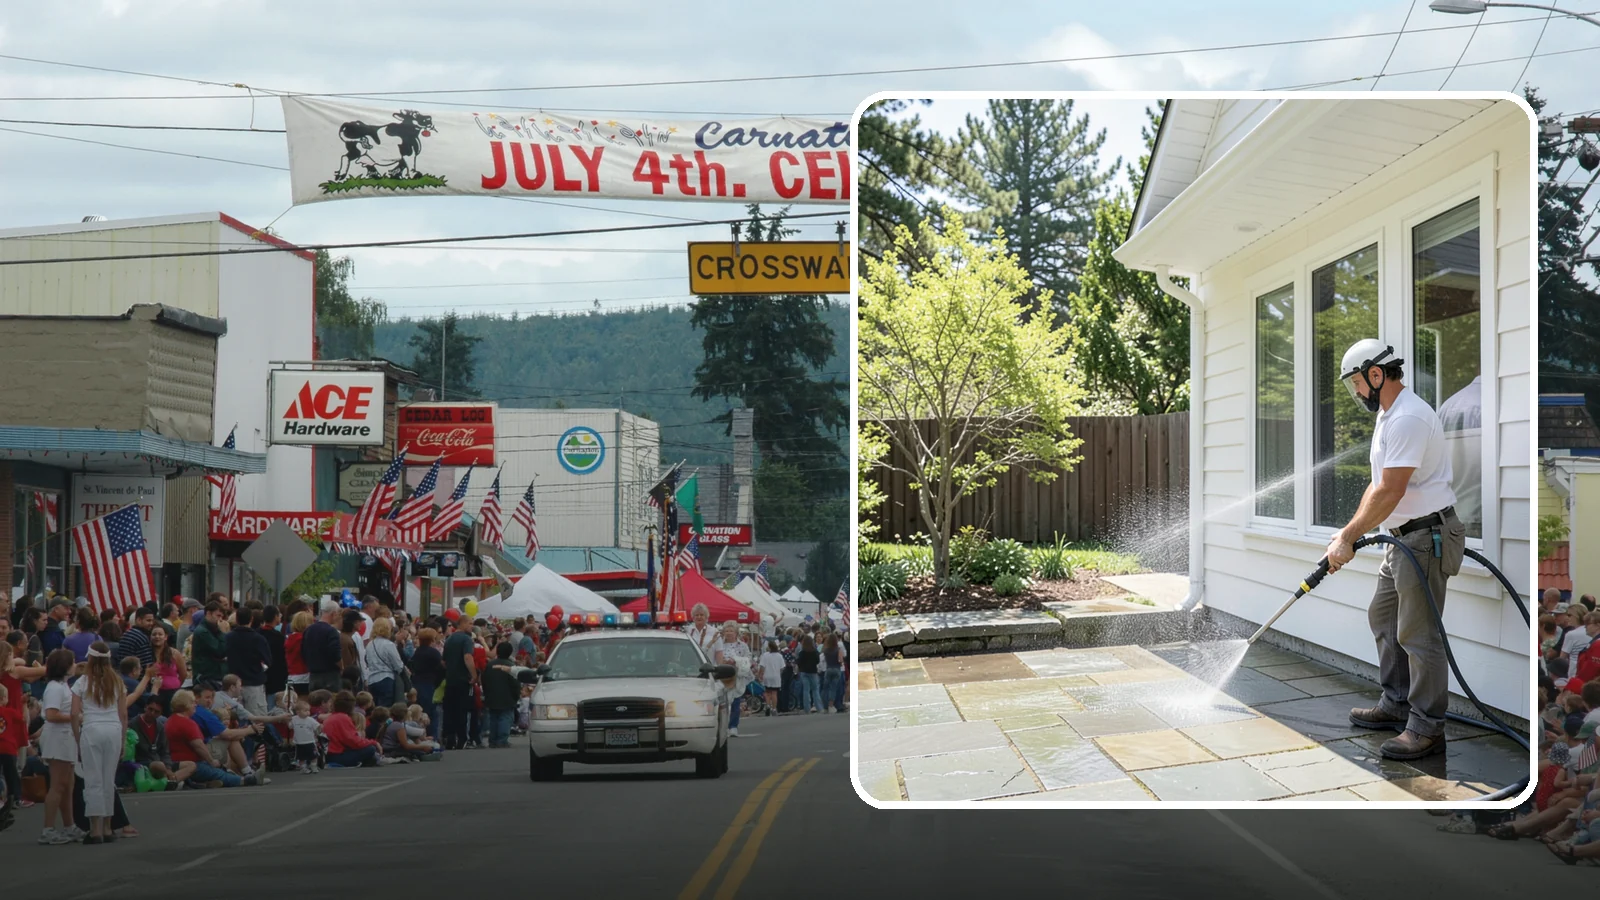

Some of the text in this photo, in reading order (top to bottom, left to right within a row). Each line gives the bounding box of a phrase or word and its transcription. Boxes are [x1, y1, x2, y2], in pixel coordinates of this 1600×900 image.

[481, 141, 605, 192] JULY
[632, 150, 746, 198] 4th.
[697, 254, 850, 280] CROSSWA
[282, 380, 373, 420] ACE
[406, 409, 452, 421] CEDAR
[283, 421, 371, 436] Hardware
[416, 428, 477, 447] Coca-Cola
[353, 467, 384, 480] Simpl
[96, 485, 124, 494] Vincent
[126, 486, 136, 494] de
[138, 486, 155, 495] Paul
[688, 526, 741, 535] CRNATION
[699, 535, 730, 543] GLASS
